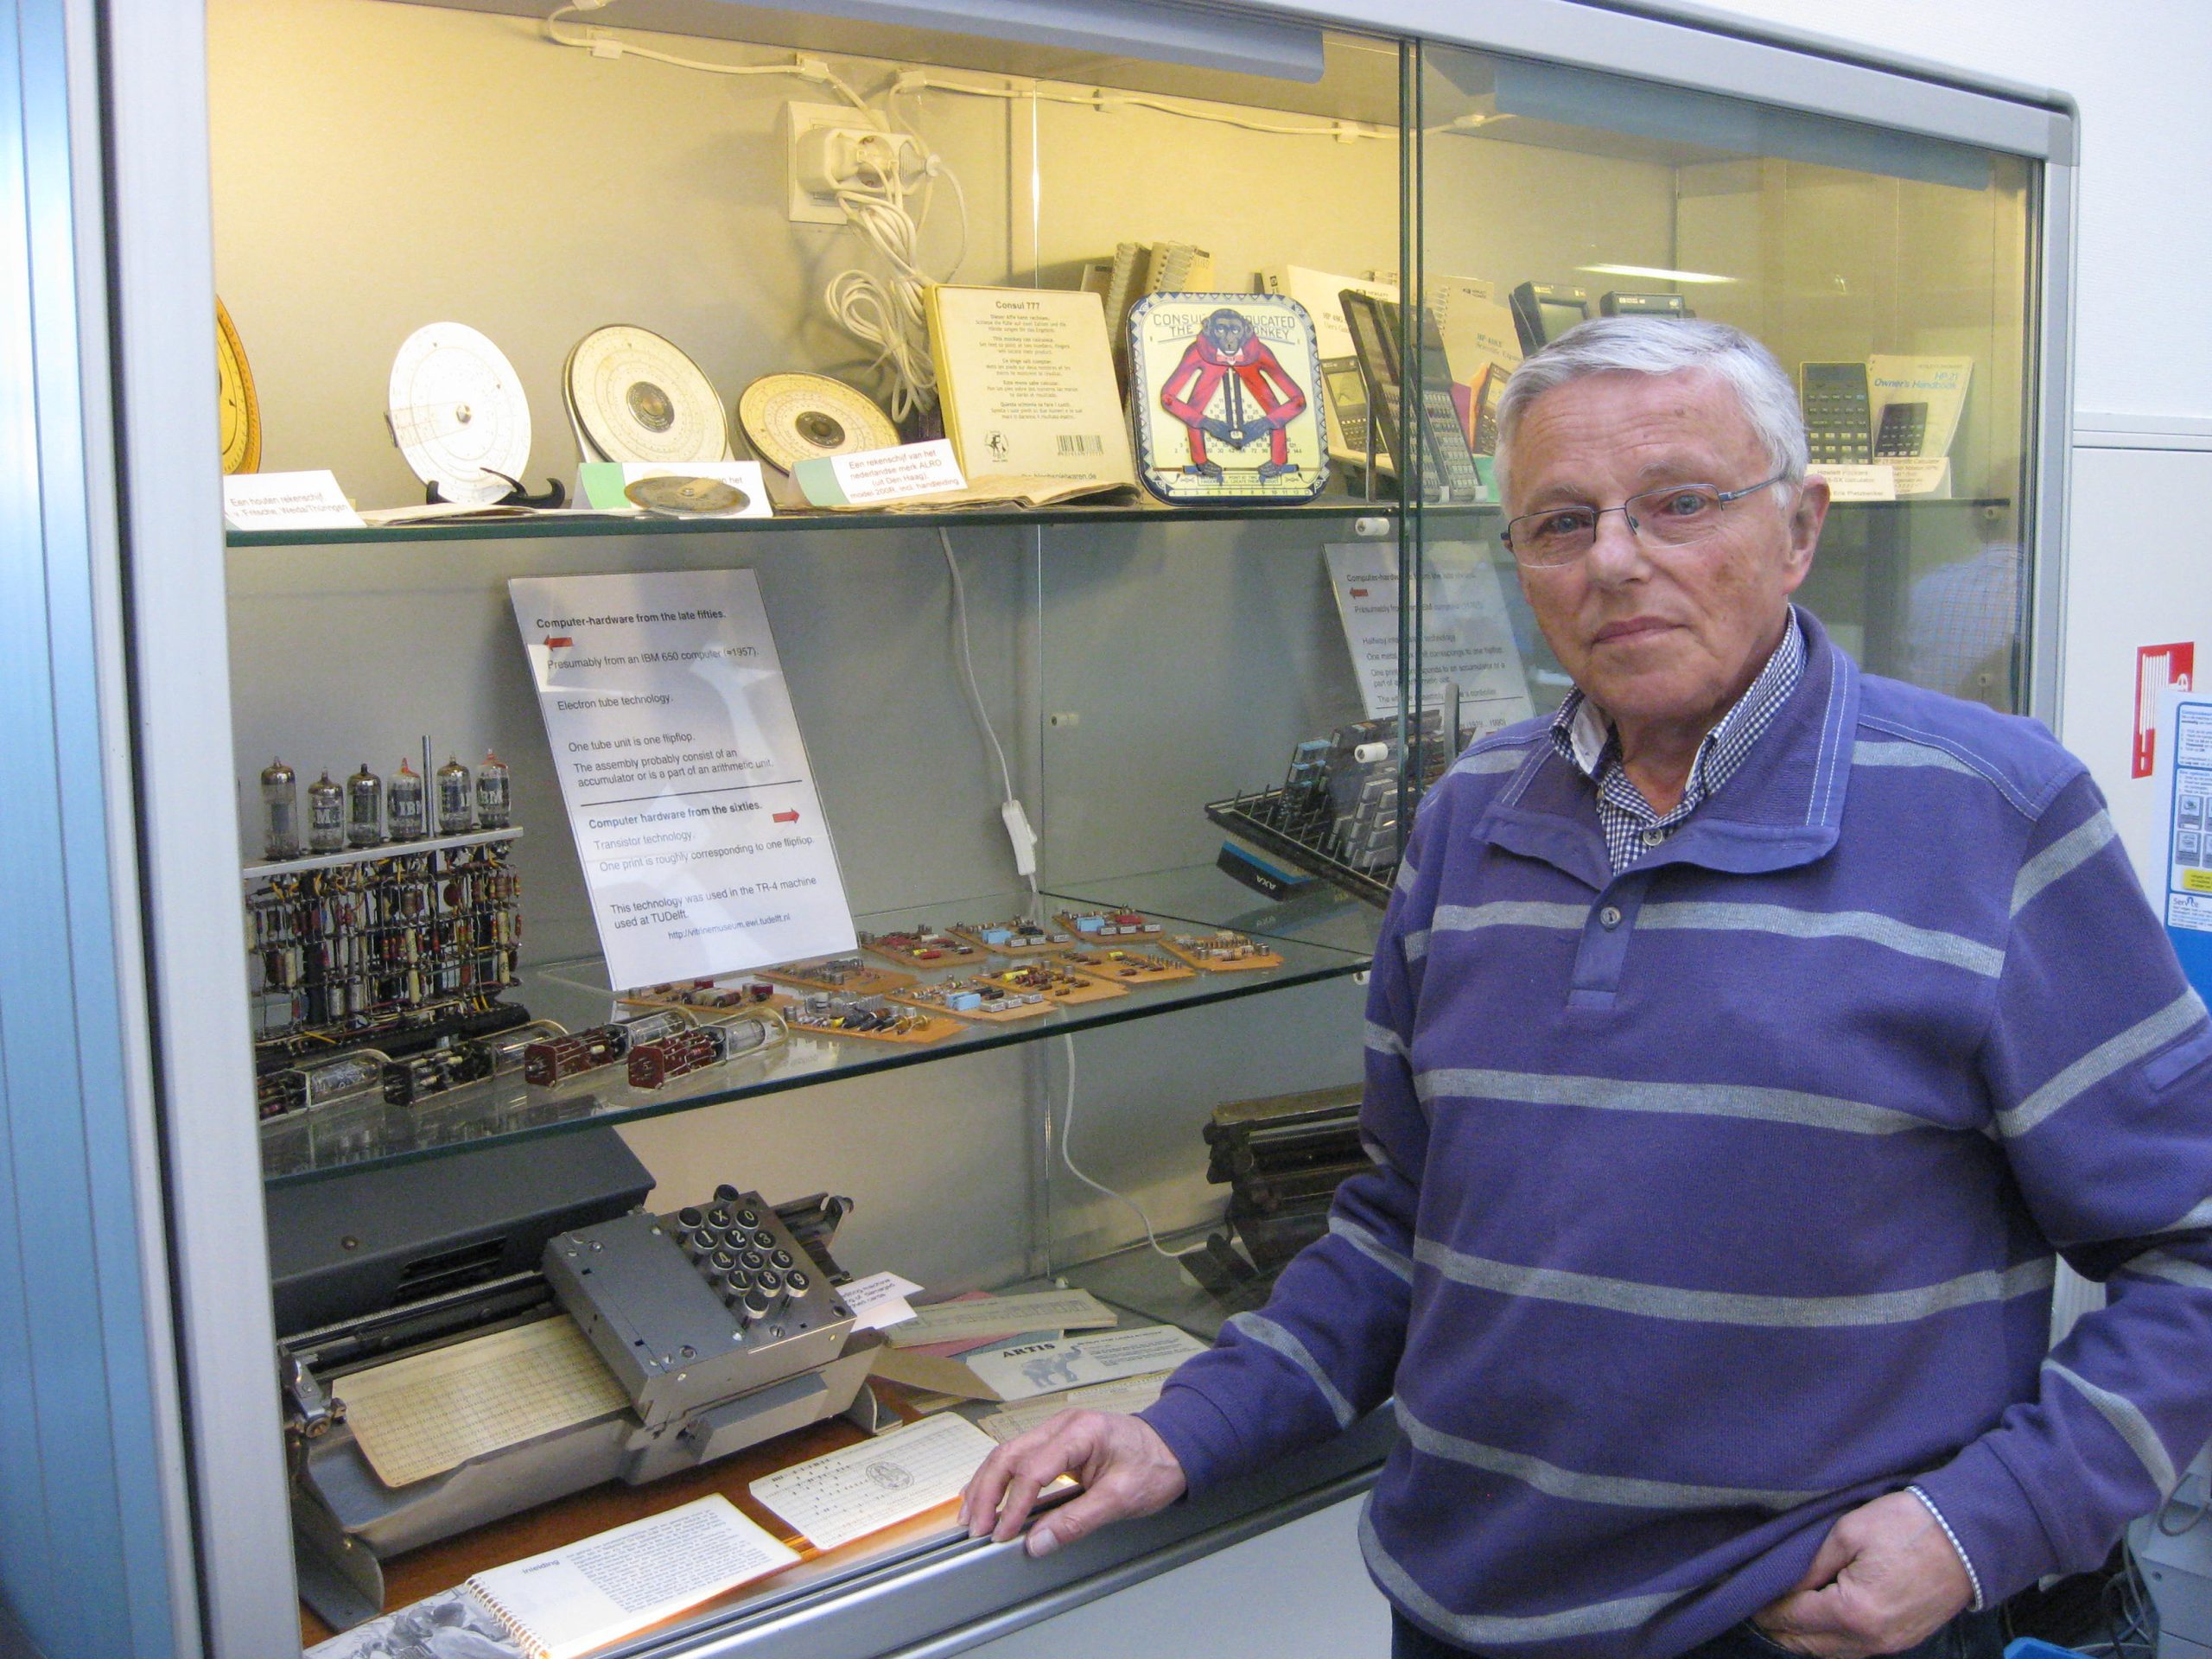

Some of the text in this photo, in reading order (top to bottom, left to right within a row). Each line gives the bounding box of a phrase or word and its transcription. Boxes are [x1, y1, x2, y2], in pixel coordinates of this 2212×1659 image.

[995, 301, 1040, 311] Consul 777
[1245, 315, 1296, 329] DUCATED
[1170, 326, 1289, 340] THE ONKEY
[1873, 378, 1910, 389] Owner's
[908, 452, 922, 461] van
[923, 449, 938, 458] het
[919, 459, 942, 469] ALRO
[536, 609, 727, 629] Computer-hardware from the late fifties.
[548, 654, 602, 671] Presumably
[603, 653, 626, 666] from
[627, 655, 640, 665] an
[641, 652, 660, 664] IBM
[661, 651, 679, 662] 650
[680, 648, 721, 664] computer
[557, 693, 674, 711] Electron tube technology.
[568, 732, 696, 753] One tube unit is one flipflop.
[574, 748, 738, 774] The assembly probably consist of an
[577, 772, 635, 789] accumulator
[636, 772, 648, 782] or
[648, 770, 658, 780] is
[658, 771, 665, 779] a
[666, 768, 686, 781] part
[686, 766, 697, 777] of
[697, 766, 710, 776] an
[711, 760, 754, 775] arithmetic
[588, 801, 763, 831] Computer hardware from the sixties.
[593, 830, 696, 852] Transistor technology.
[599, 835, 815, 873] One print is roughly corresponding to one flipflop.
[610, 875, 818, 915] This technology was used in the TR-4 machine
[614, 918, 639, 930] used
[639, 916, 651, 927] at
[701, 1230, 714, 1243] 1
[731, 1230, 746, 1243] 2
[759, 1232, 772, 1244] 3
[718, 1252, 731, 1263] 4
[746, 1251, 760, 1264] 5
[777, 1250, 790, 1263] 6
[734, 1270, 747, 1285] 7
[763, 1271, 776, 1284] 8
[792, 1273, 805, 1286] 9
[1002, 1342, 1056, 1358] ARTIS
